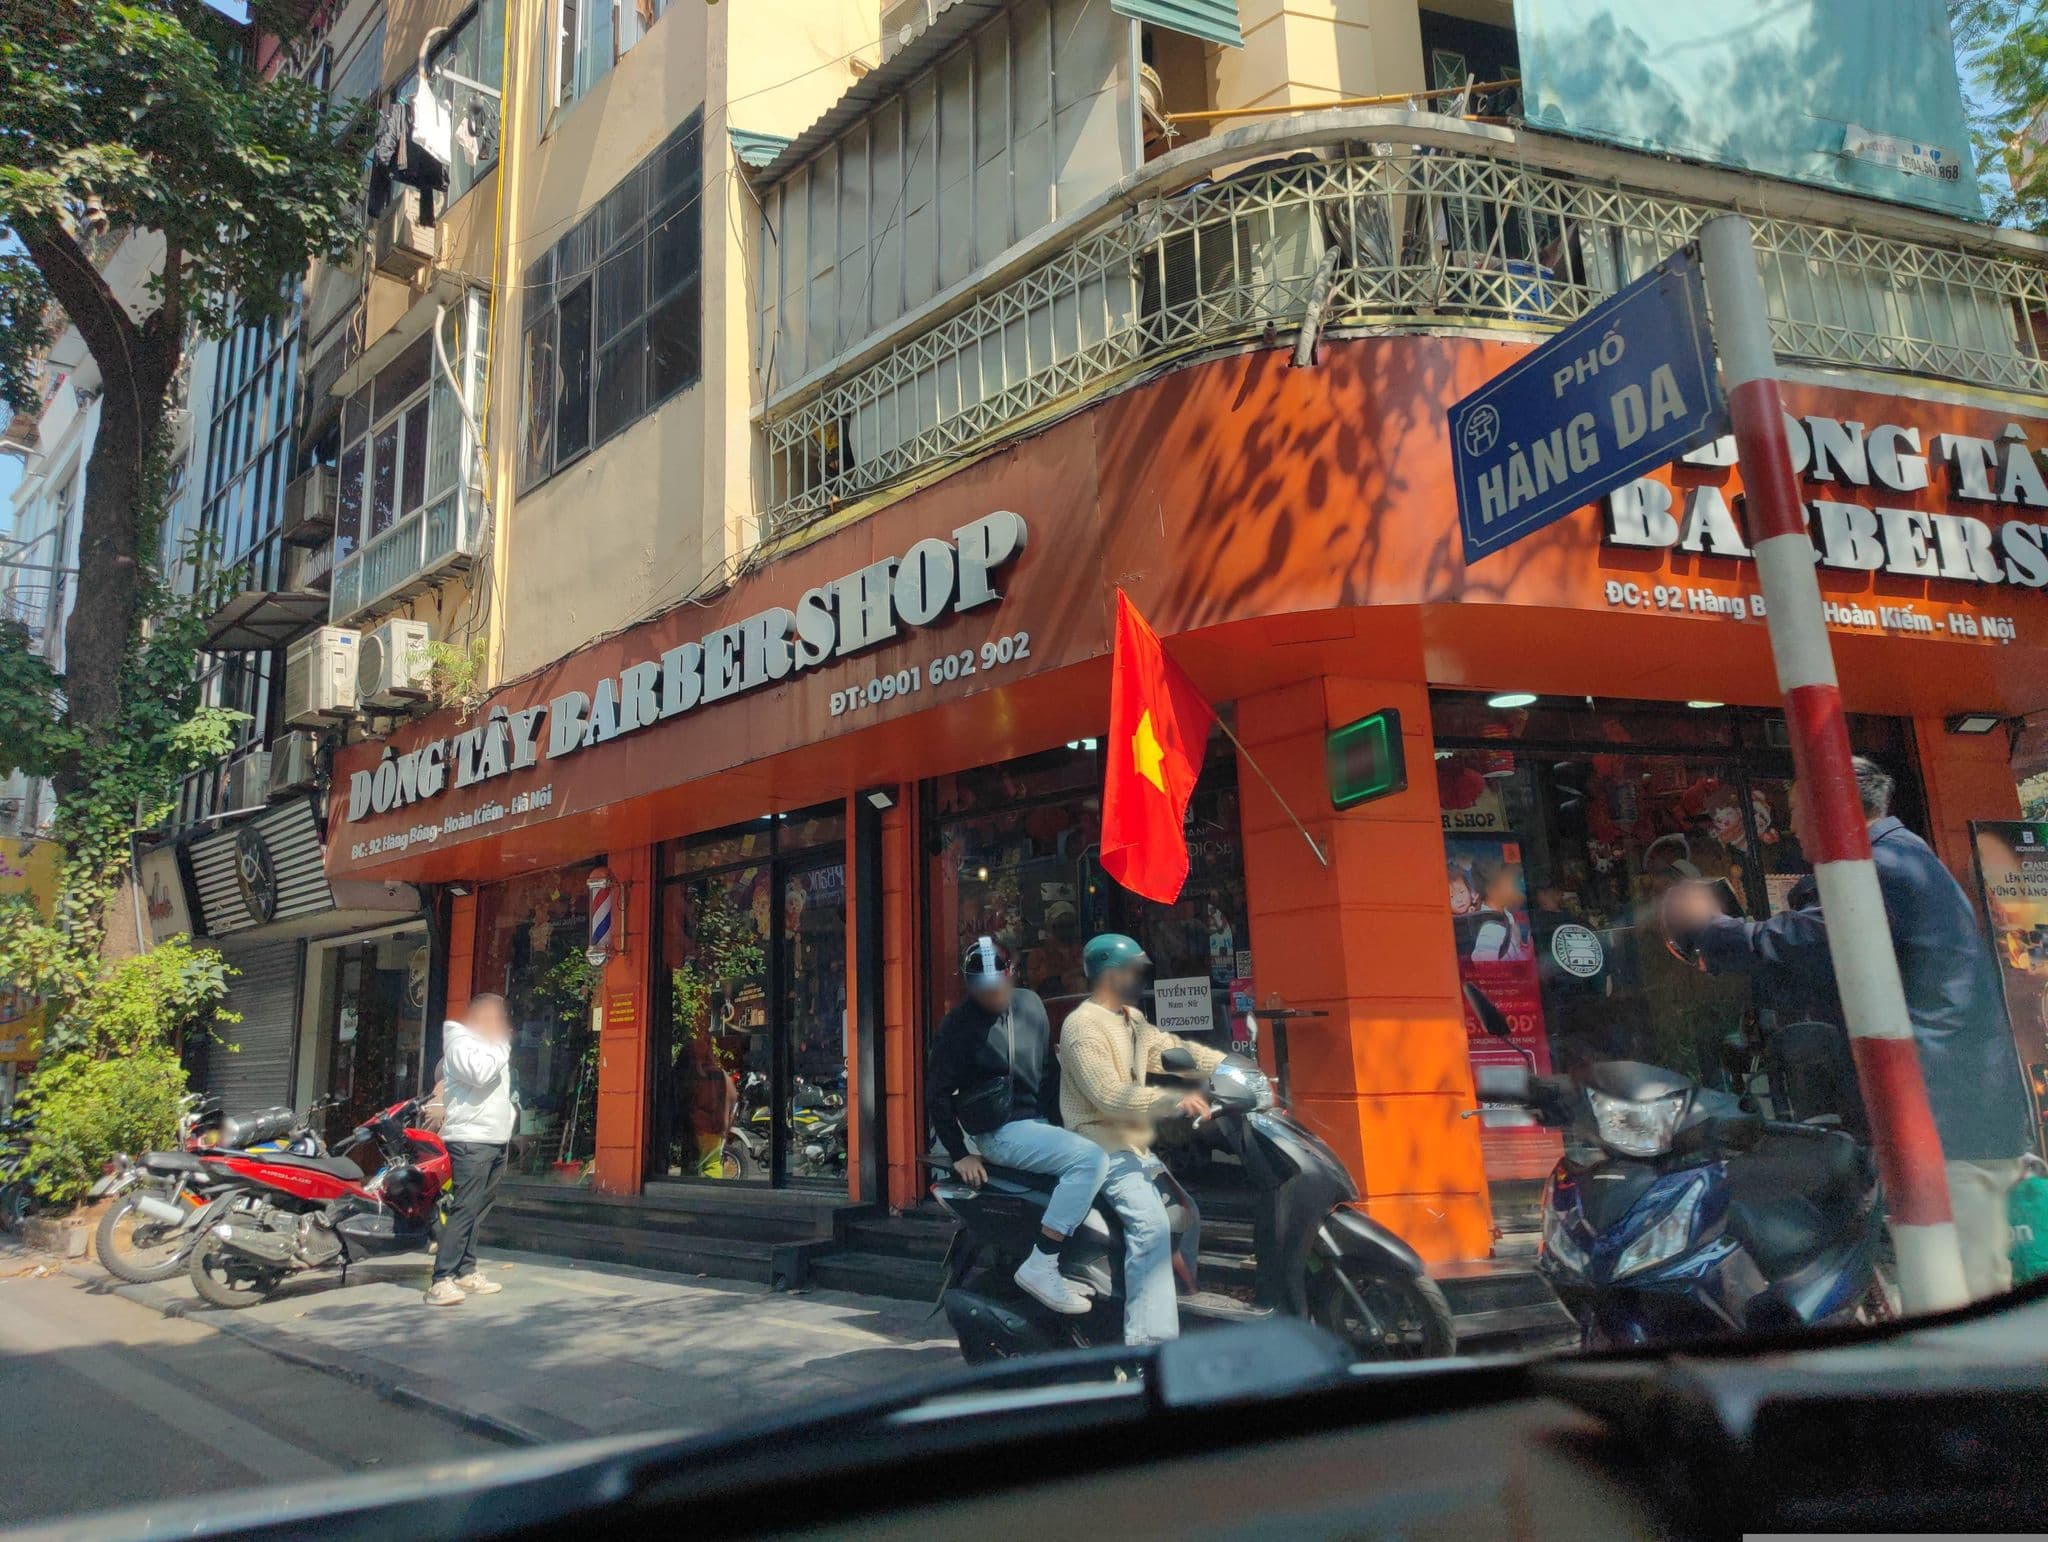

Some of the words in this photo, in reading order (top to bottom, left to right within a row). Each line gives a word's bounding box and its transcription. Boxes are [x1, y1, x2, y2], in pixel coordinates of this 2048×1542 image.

[1553, 319, 1625, 399] PHỐ
[1477, 411, 1601, 525] HÀNG
[1610, 363, 1688, 450] DA
[1940, 423, 2048, 506] TÂ
[1609, 477, 2048, 588] BABERS
[1653, 585, 1684, 609] 92
[1687, 588, 1747, 620] Hàng
[1823, 601, 1877, 626] Hoàn
[1880, 604, 1933, 632] Kiếm
[1949, 612, 1978, 637] Hà
[1982, 615, 2016, 645] Nội
[929, 649, 976, 687] 602
[981, 632, 1030, 670] 902
[453, 705, 548, 789] TÂY
[369, 838, 382, 855] 92
[382, 832, 409, 851] Hàng
[443, 811, 473, 834] Hoàn
[473, 800, 504, 826] Kiếm
[511, 792, 529, 815] Hà
[531, 784, 552, 811] Nội
[1455, 813, 1495, 828] SHOP
